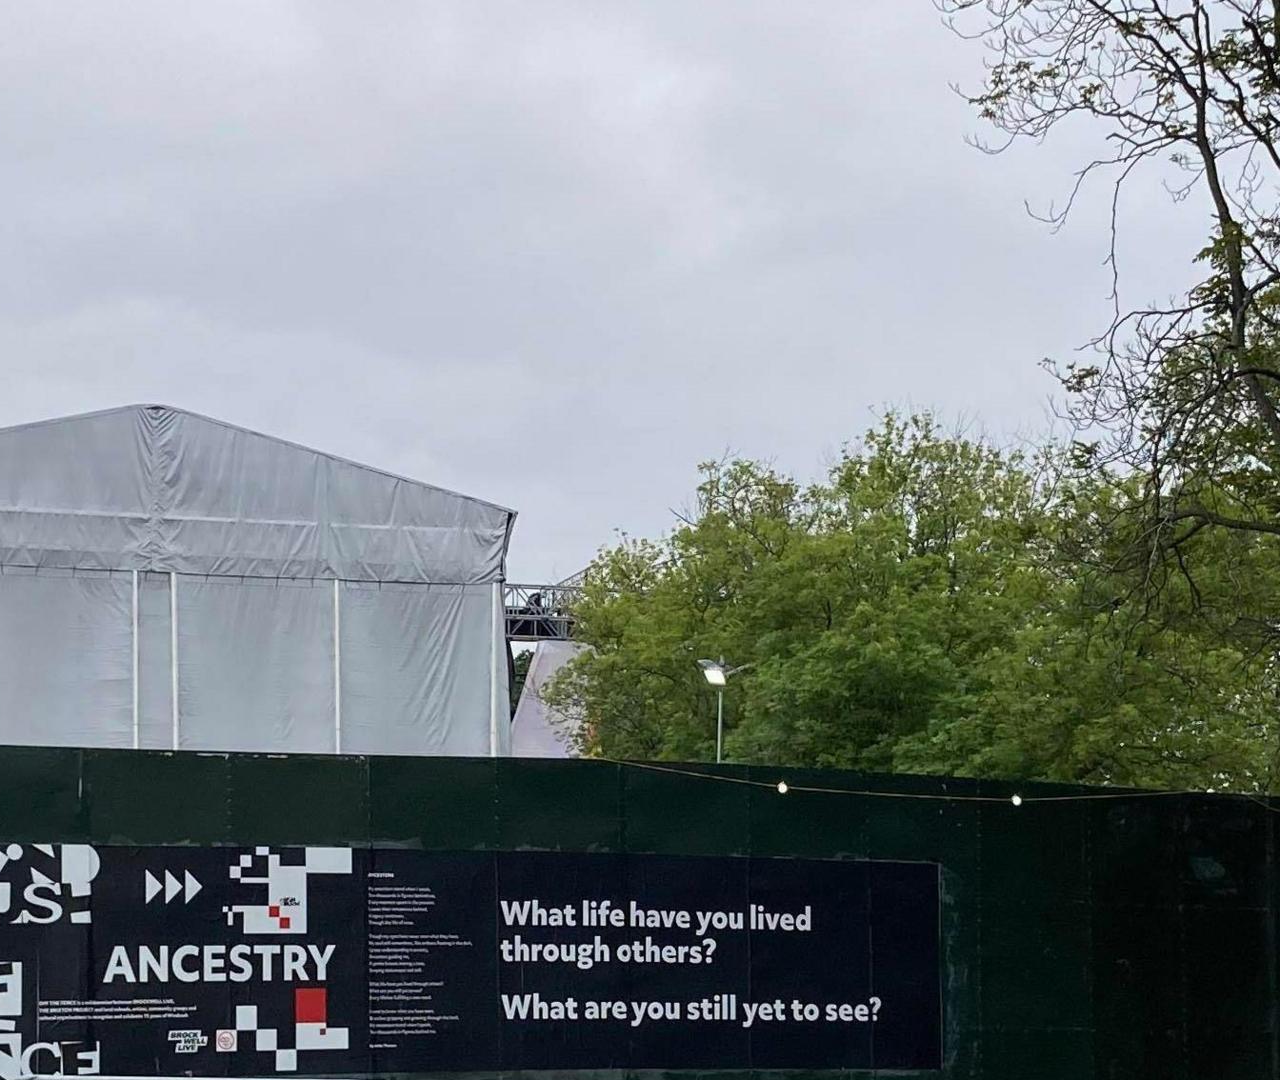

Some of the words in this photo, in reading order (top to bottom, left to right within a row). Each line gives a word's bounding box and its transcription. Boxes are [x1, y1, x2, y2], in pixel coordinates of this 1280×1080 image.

[500, 900, 577, 927] What
[583, 900, 625, 928] life
[630, 901, 691, 929] have
[696, 911, 744, 936] you
[750, 904, 812, 932] lived
[102, 944, 336, 983] ANCESTRY
[500, 936, 610, 970] through
[617, 937, 717, 964] others?
[501, 992, 579, 1020] What
[584, 1001, 627, 1021] are
[631, 1003, 681, 1027] you
[686, 993, 737, 1021] still
[742, 999, 786, 1028] yet
[790, 1000, 820, 1022] to
[825, 996, 882, 1022] see?
